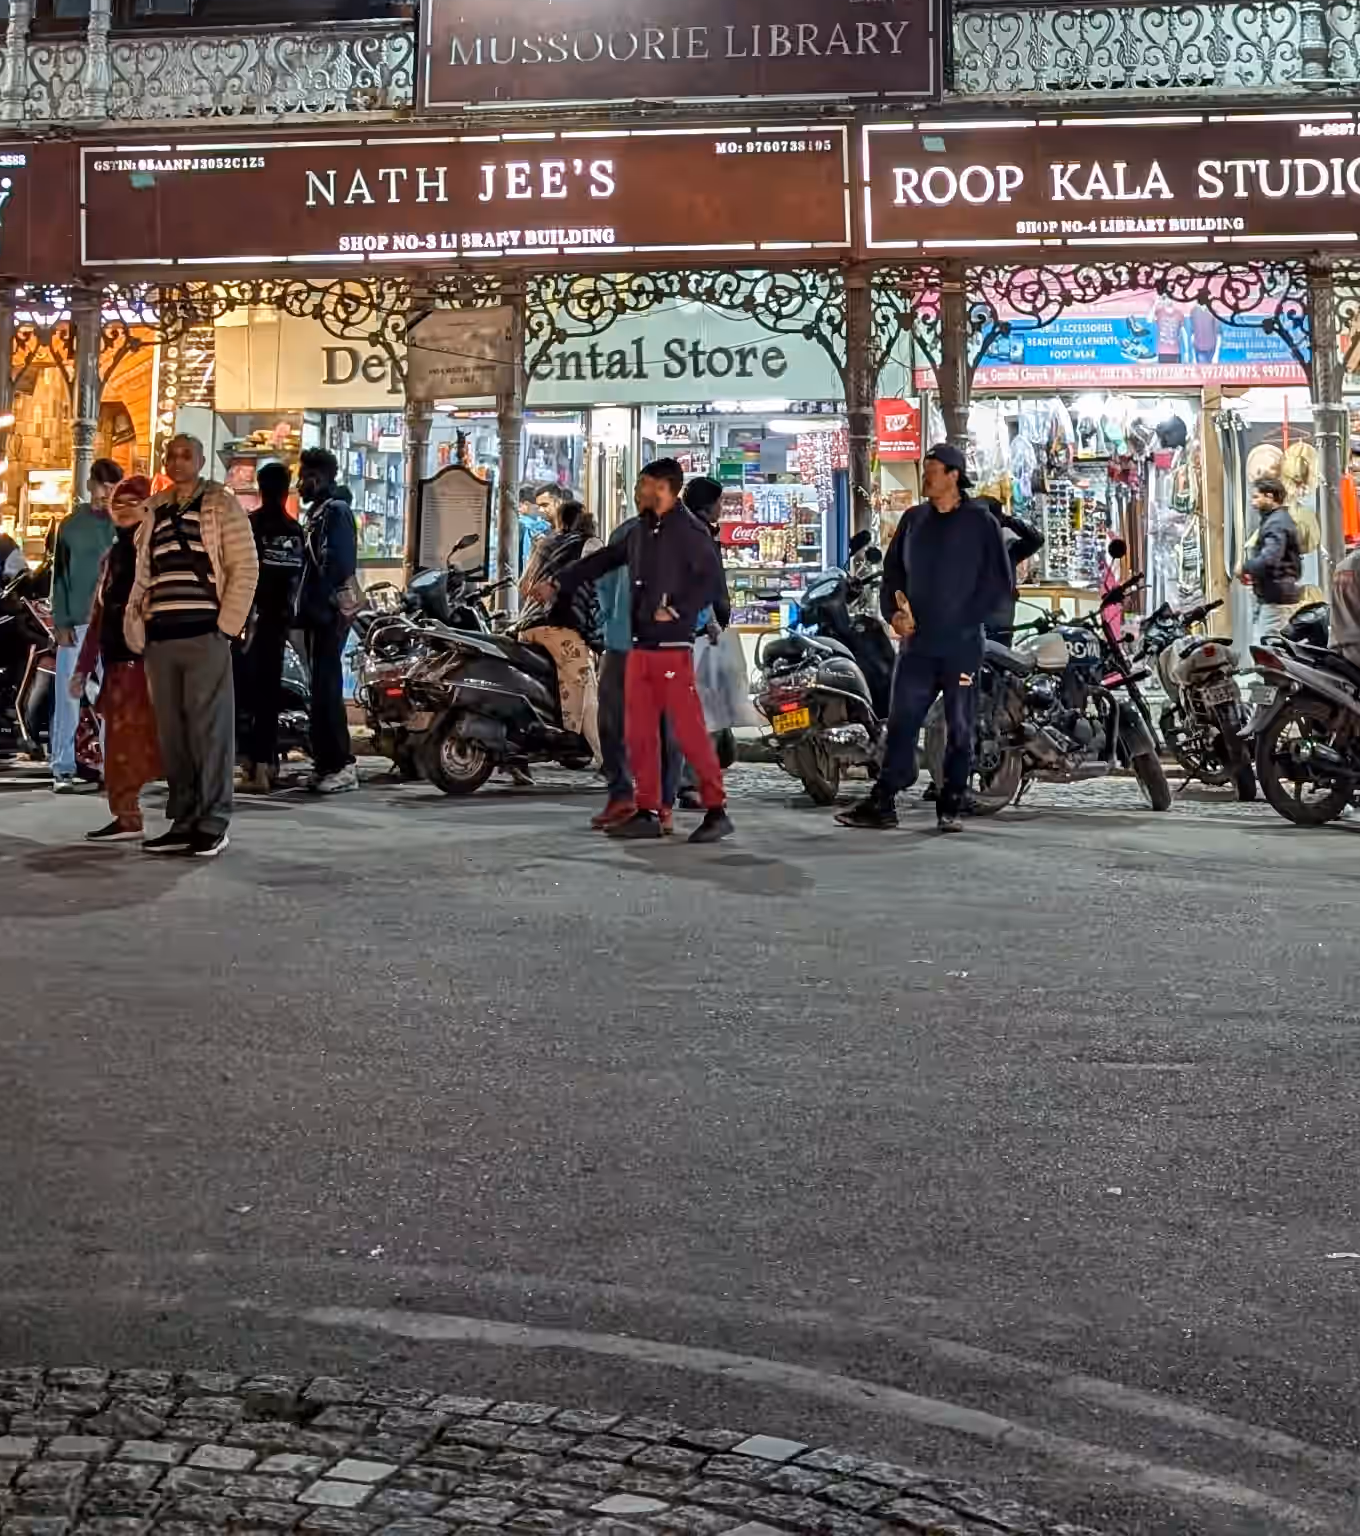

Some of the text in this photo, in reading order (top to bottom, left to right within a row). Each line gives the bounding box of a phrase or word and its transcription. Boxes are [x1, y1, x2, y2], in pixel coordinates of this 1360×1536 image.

[448, 19, 910, 66] MUSSOORIE LIBRARY
[304, 158, 616, 206] NATH JEE'S
[892, 164, 1025, 206] ROOP
[1049, 160, 1175, 202] KALA
[339, 234, 389, 251] SHOP
[439, 230, 520, 249] LIBRARY
[524, 227, 616, 247] BUILDING
[1016, 220, 1059, 235] SHOP
[1099, 217, 1166, 233] LIBRARY
[1168, 216, 1245, 232] BUILDING
[663, 336, 789, 380] Store
